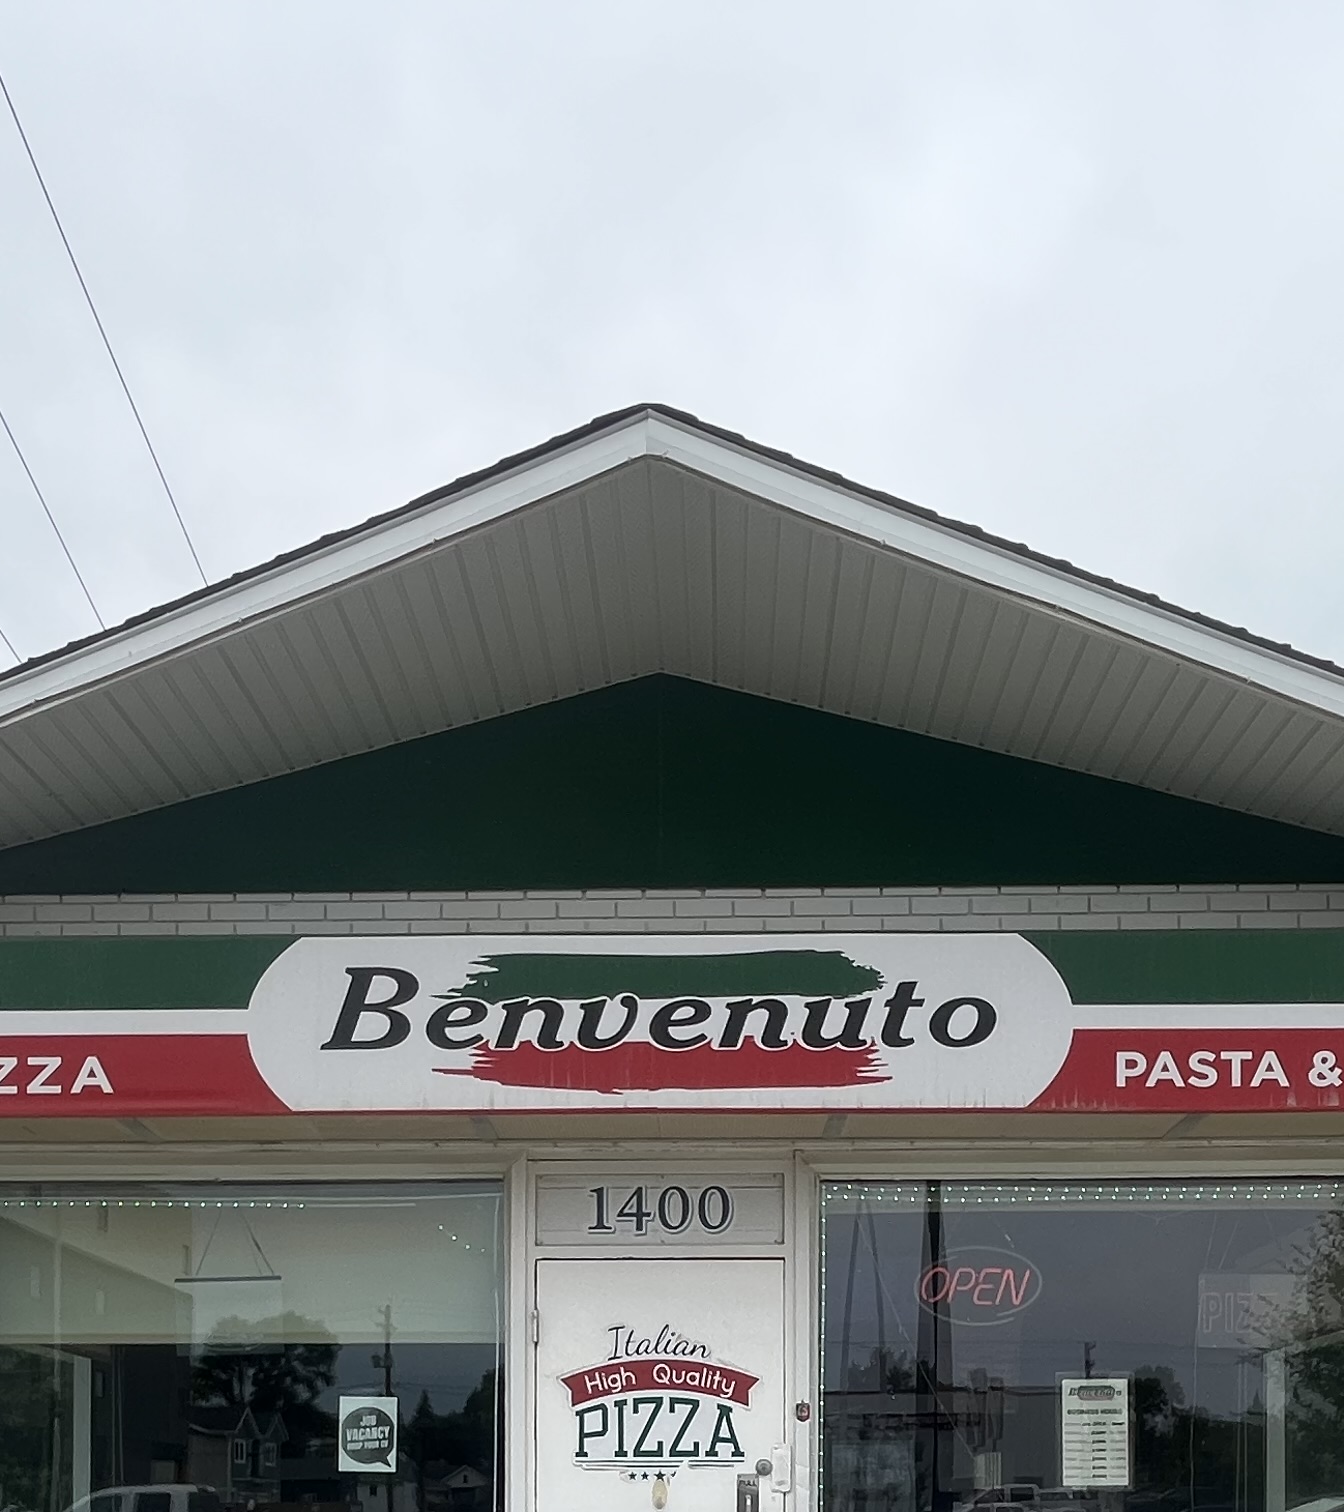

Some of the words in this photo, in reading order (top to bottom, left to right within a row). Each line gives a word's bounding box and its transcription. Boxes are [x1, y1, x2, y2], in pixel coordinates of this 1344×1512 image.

[320, 966, 998, 1051] Benvenuto
[1115, 1050, 1290, 1088] PASTA
[1308, 1050, 1343, 1088] &
[587, 1186, 731, 1232] 1400
[920, 1267, 1030, 1305] OPEN
[608, 1324, 711, 1361] Italian
[584, 1367, 637, 1394] High
[652, 1363, 736, 1398] Quality
[346, 1426, 390, 1441] VACANCY
[575, 1396, 745, 1458] PIZZA
